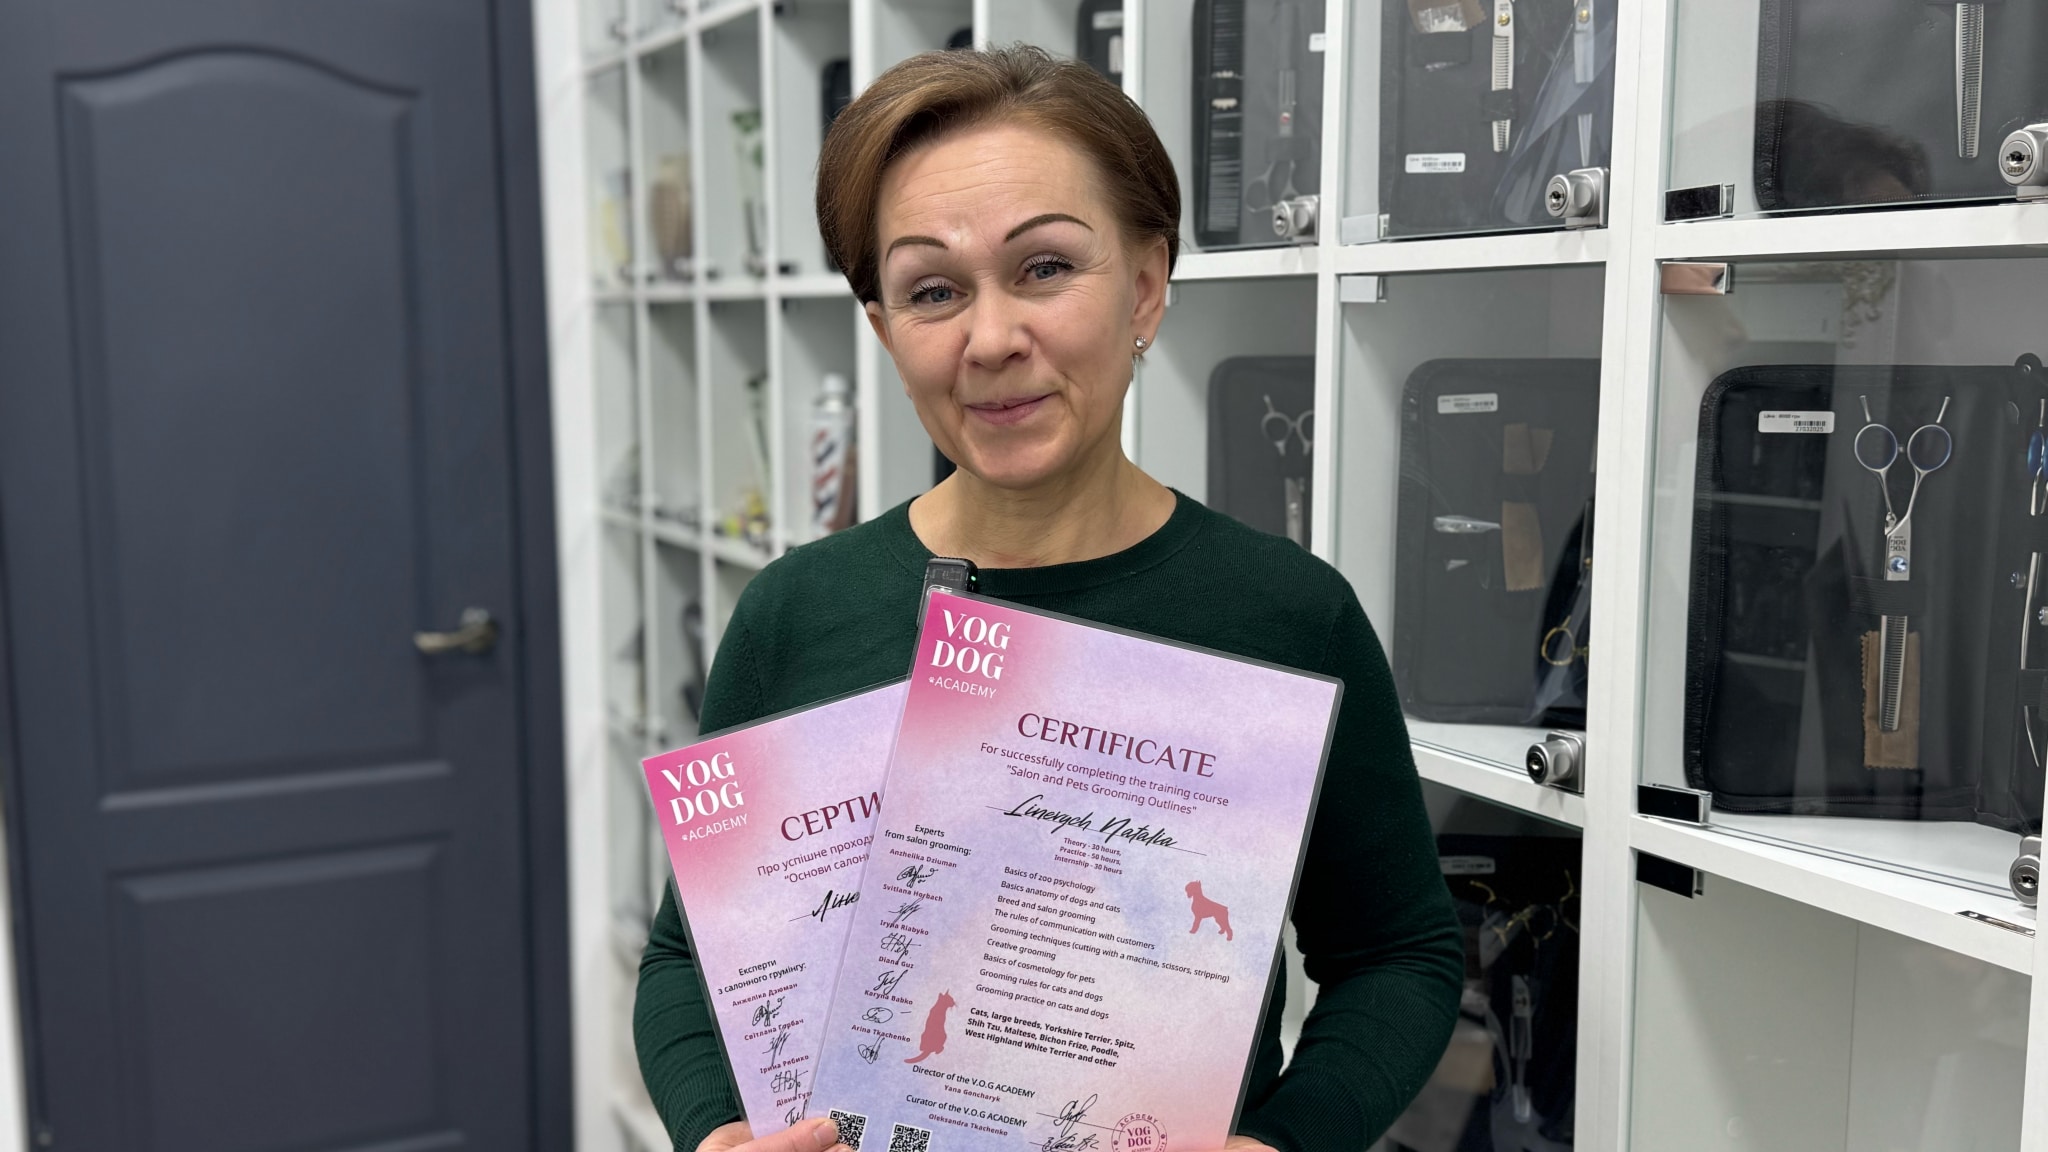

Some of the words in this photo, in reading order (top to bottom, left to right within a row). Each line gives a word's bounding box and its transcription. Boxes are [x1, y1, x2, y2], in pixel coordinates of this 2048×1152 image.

[942, 608, 1011, 650] V.O.G
[930, 639, 1004, 681] DOG
[933, 675, 997, 699] ACADEMY
[1017, 712, 1216, 778] CERTIFICATE
[660, 751, 735, 793] V.O.G
[980, 742, 999, 754] For
[1000, 748, 1065, 772] successfully
[1066, 763, 1127, 786] completing
[1128, 775, 1147, 788] the
[1149, 780, 1191, 800] training
[1193, 792, 1229, 807] course
[669, 780, 744, 825] DOG
[1006, 764, 1040, 780] "Salon
[1042, 774, 1064, 786] and
[1065, 777, 1089, 791] Pets
[1091, 783, 1145, 806] Grooming
[1147, 796, 1197, 815] Outlines"
[688, 812, 748, 842] ACADEMY
[914, 824, 945, 837] Experts
[1003, 794, 1093, 834] Linerych
[1099, 817, 1176, 847] Natalia
[884, 829, 905, 840] from
[905, 835, 928, 846] salon
[929, 840, 972, 856] grooming:
[1059, 846, 1087, 857] Practice
[1100, 854, 1121, 866] hours,
[1063, 837, 1087, 849] Theory
[1100, 845, 1121, 856] hours,
[757, 863, 780, 876] Про
[781, 848, 828, 872] успішне
[889, 848, 924, 861] Anzhelika
[926, 856, 957, 868] Dziuman
[1054, 854, 1089, 868] Internship
[1102, 864, 1122, 875] hours
[784, 864, 832, 883] “Основи
[1004, 866, 1028, 878] Basics
[1037, 874, 1052, 883] zoo
[1052, 878, 1096, 894] psychology
[882, 883, 912, 895] Svitlana
[913, 890, 943, 902] Horbach
[1000, 880, 1024, 892] Basics
[1025, 887, 1059, 901] anatomy
[1069, 895, 1088, 907] dogs
[1089, 901, 1105, 909] and
[1105, 904, 1120, 913] cats
[997, 894, 1020, 906] Breed
[1020, 901, 1036, 910] and
[1036, 904, 1058, 914] salon
[1058, 909, 1096, 925] grooming
[879, 919, 899, 929] Iryna
[900, 924, 929, 936] Riabyko
[994, 908, 1009, 918] The
[1009, 913, 1029, 922] rules
[1039, 919, 1097, 937] communication
[1098, 932, 1115, 941] with
[1116, 936, 1155, 950] customers
[878, 956, 901, 966] Diana
[900, 961, 914, 969] Guz
[986, 938, 1018, 951] Creative
[1018, 946, 1056, 961] grooming
[990, 923, 1029, 940] Grooming
[1029, 932, 1071, 948] techniques
[1071, 941, 1101, 956] (cutting
[1102, 949, 1119, 958] with
[1126, 954, 1160, 968] machine,
[1161, 962, 1192, 975] scissors,
[1193, 969, 1230, 983] stripping)
[724, 974, 768, 993] салонного
[768, 962, 806, 980] грумінгу:
[738, 959, 777, 976] Експерти
[983, 952, 1007, 964] Basics
[1017, 961, 1066, 979] cosmetology
[1066, 970, 1078, 980] for
[1078, 975, 1095, 984] pets
[864, 989, 889, 1000] Karyna
[890, 995, 913, 1005] Babko
[979, 968, 1018, 984] Grooming
[1018, 978, 1038, 987] rules
[1039, 981, 1051, 990] for
[1051, 985, 1067, 994] cats
[1068, 988, 1084, 997] and
[1084, 991, 1103, 1002] dogs
[975, 983, 1014, 1000] Grooming
[1014, 993, 1045, 1005] practice
[1057, 1003, 1073, 1011] cats
[1074, 1006, 1090, 1015] and
[1090, 1009, 1109, 1020] dogs
[851, 1024, 871, 1034] Arina
[873, 1028, 911, 1042] Tkachenko
[967, 1017, 985, 1028] Shih
[986, 1021, 1002, 1033] Tzu,
[1004, 1025, 1037, 1040] Maltese,
[1039, 1033, 1067, 1046] Bichon
[1068, 1039, 1089, 1052] Frize,
[1090, 1044, 1119, 1058] Poodle,
[970, 1007, 989, 1018] Cats,
[991, 1011, 1012, 1023] large
[1013, 1016, 1042, 1030] breeds,
[1044, 1023, 1083, 1038] Yorkshire
[1084, 1031, 1113, 1045] Terrier,
[1114, 1038, 1135, 1050] Spitz,
[965, 1028, 985, 1039] West
[986, 1033, 1023, 1047] Highland
[1024, 1041, 1048, 1053] White
[1049, 1046, 1077, 1059] Terrier
[1077, 1054, 1094, 1063] and
[1094, 1058, 1117, 1067] other
[912, 1064, 945, 1078] Director
[956, 1075, 970, 1084] the
[971, 1077, 994, 1090] V.O.G
[994, 1083, 1036, 1098] ACADEMY
[944, 1084, 962, 1094] Yana
[962, 1089, 1001, 1103] Goncharyk
[906, 1094, 937, 1107] Curator
[948, 1103, 962, 1113] the
[963, 1106, 986, 1119] V.O.G
[986, 1112, 1027, 1127] ACADEMY
[928, 1113, 968, 1127] Oleksandra
[970, 1122, 1008, 1136] Tkachenko
[1120, 1114, 1158, 1127] ACADEMY
[1127, 1126, 1150, 1137] VOG
[1128, 1137, 1151, 1147] DOG
